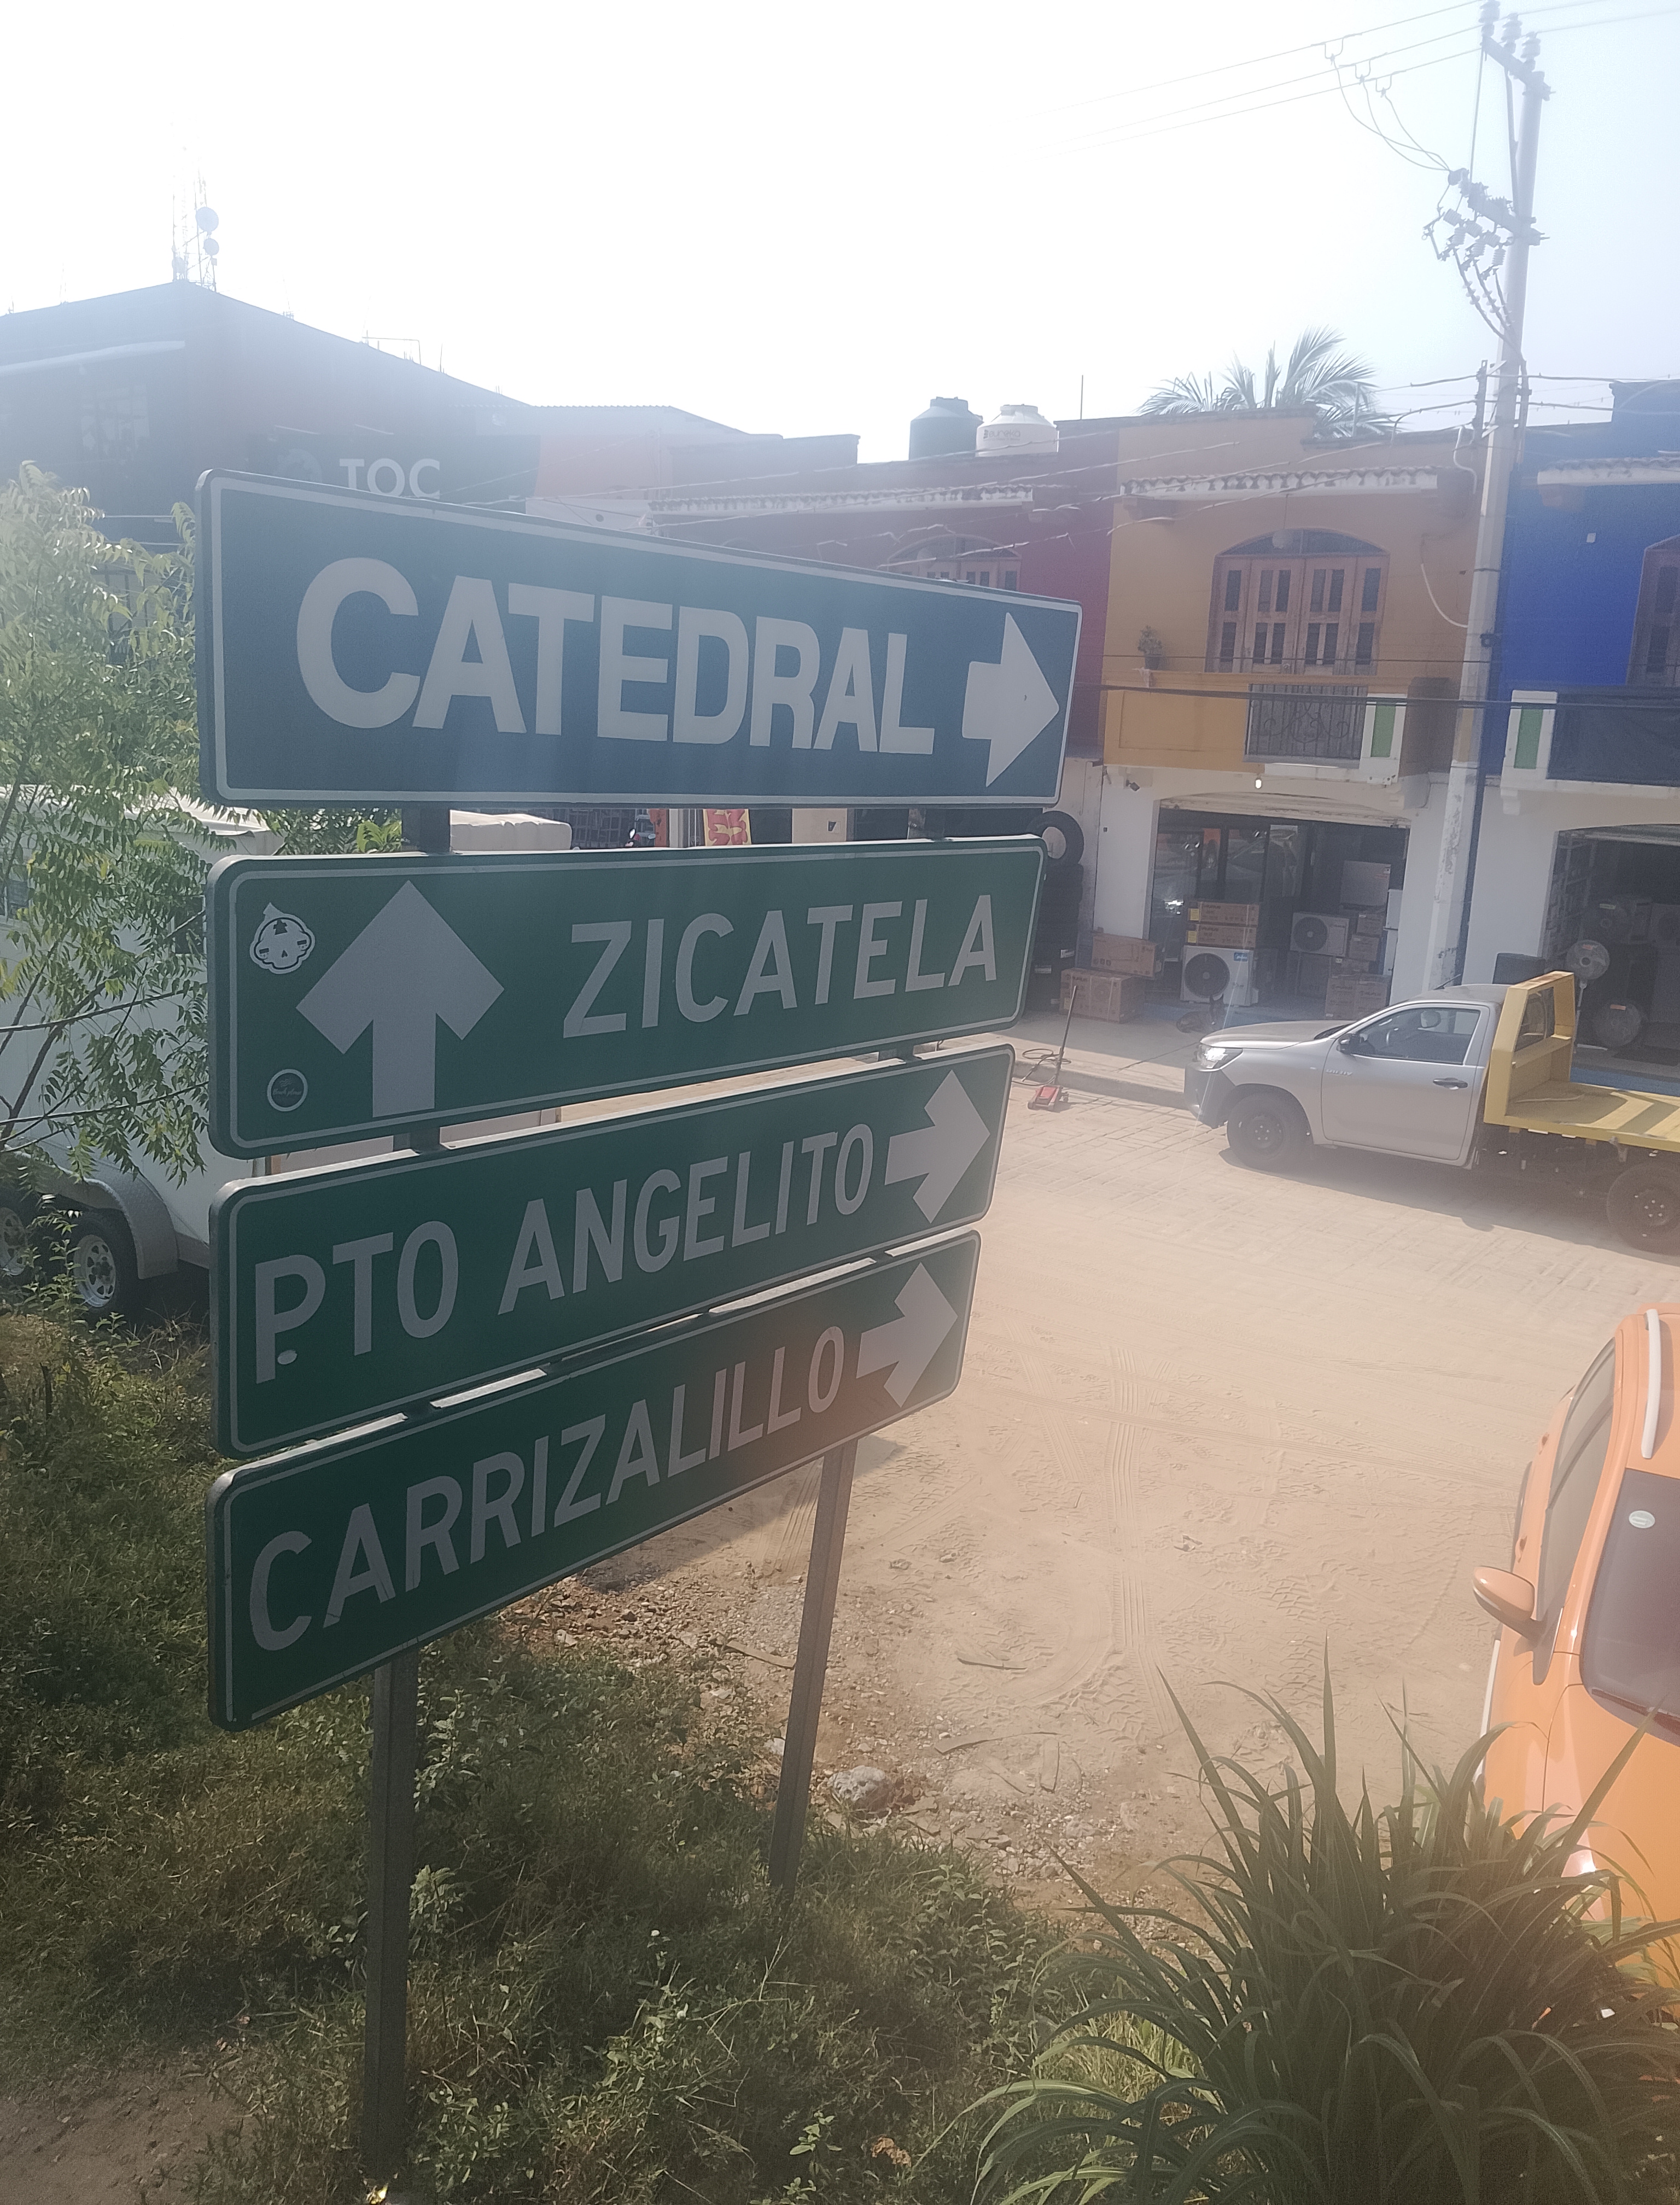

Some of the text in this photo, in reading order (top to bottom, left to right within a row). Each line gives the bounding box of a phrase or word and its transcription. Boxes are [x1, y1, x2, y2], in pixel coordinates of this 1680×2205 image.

[339, 457, 440, 499] TOC
[296, 556, 935, 755] CATEDRAL
[563, 894, 996, 1039] ZICATELA
[255, 1124, 874, 1384] PTO ANGELITO
[249, 1326, 845, 1652] CARRIZALILLO
